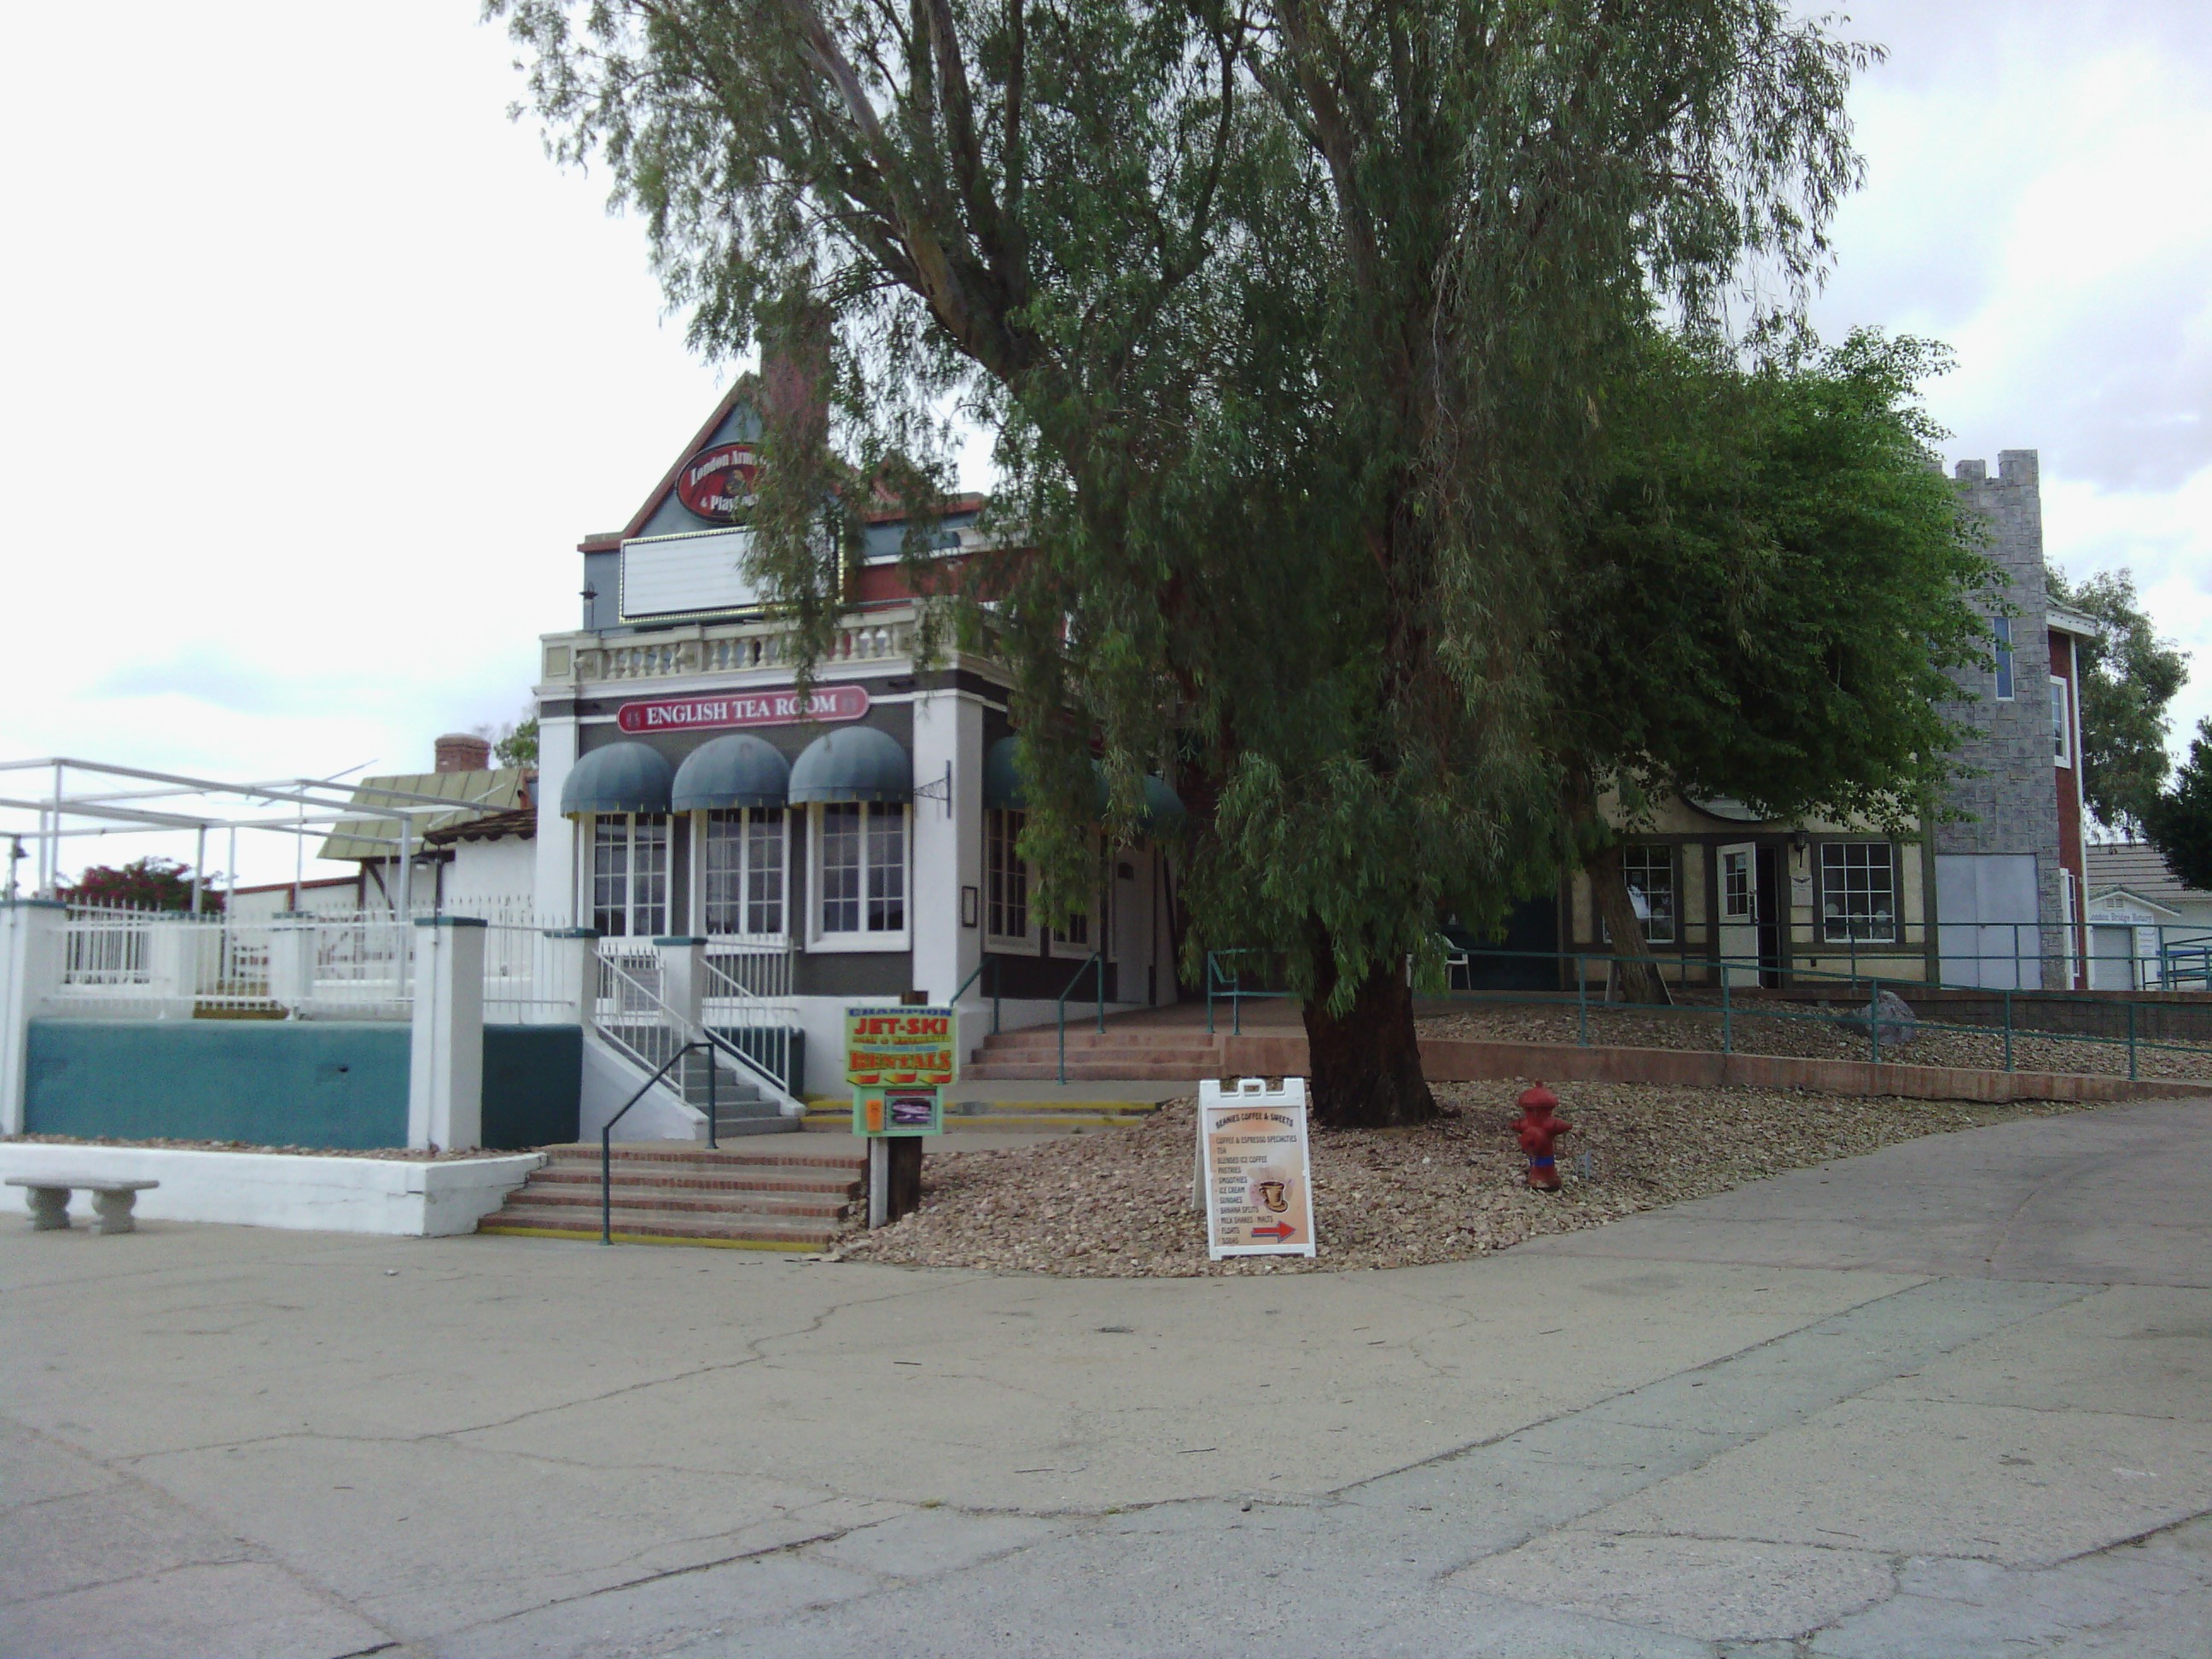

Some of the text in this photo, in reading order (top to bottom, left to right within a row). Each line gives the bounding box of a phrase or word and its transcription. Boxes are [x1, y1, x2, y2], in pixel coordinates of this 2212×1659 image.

[691, 453, 730, 486] London
[700, 497, 707, 509] &
[647, 701, 728, 725] ENGLISH
[733, 699, 771, 719] TEA
[854, 1017, 949, 1034] JET-SKI
[848, 1050, 952, 1072] RENTALS
[1241, 1112, 1262, 1121] COFFEE
[1271, 1113, 1294, 1127] SWEETS
[1267, 1134, 1297, 1144] SPECIALTIES
[1249, 1155, 1267, 1163] COFFEE
